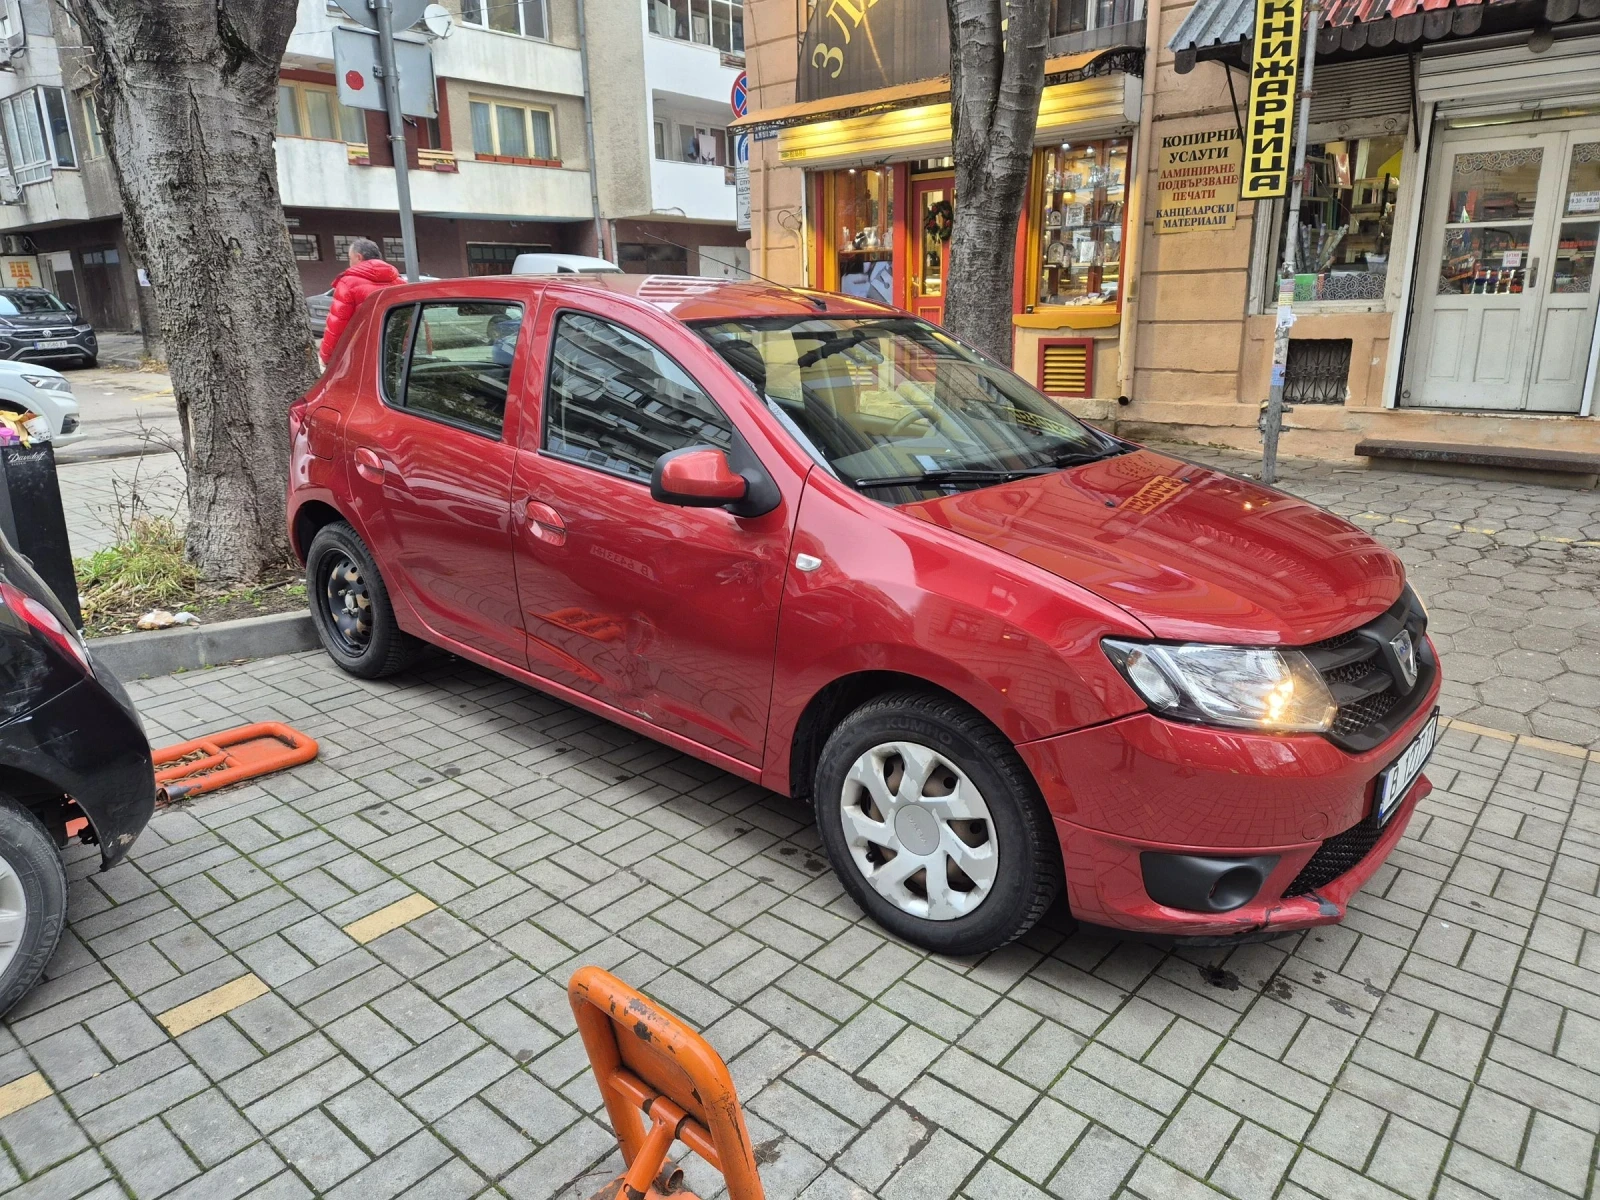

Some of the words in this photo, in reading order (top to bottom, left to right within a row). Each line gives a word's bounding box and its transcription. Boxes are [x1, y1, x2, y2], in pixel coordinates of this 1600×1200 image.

[812, 0, 880, 79] ЗЛ
[1249, 0, 1295, 191] КНИЖАРНИЦА
[1162, 128, 1242, 148] КОПИРНИ
[1169, 147, 1229, 164] УСЛУГИ
[1160, 163, 1236, 179] ЛАМИНИРАНЕ
[1158, 174, 1239, 190] ПОДВЪРЗВАНЕ
[1172, 189, 1216, 201] ПЕЧАТИ
[1156, 203, 1235, 218] КАНЦЕЛАРСКИ
[1163, 215, 1226, 228] МАТЕРИАЛИ
[887, 717, 953, 745] KUMHO
